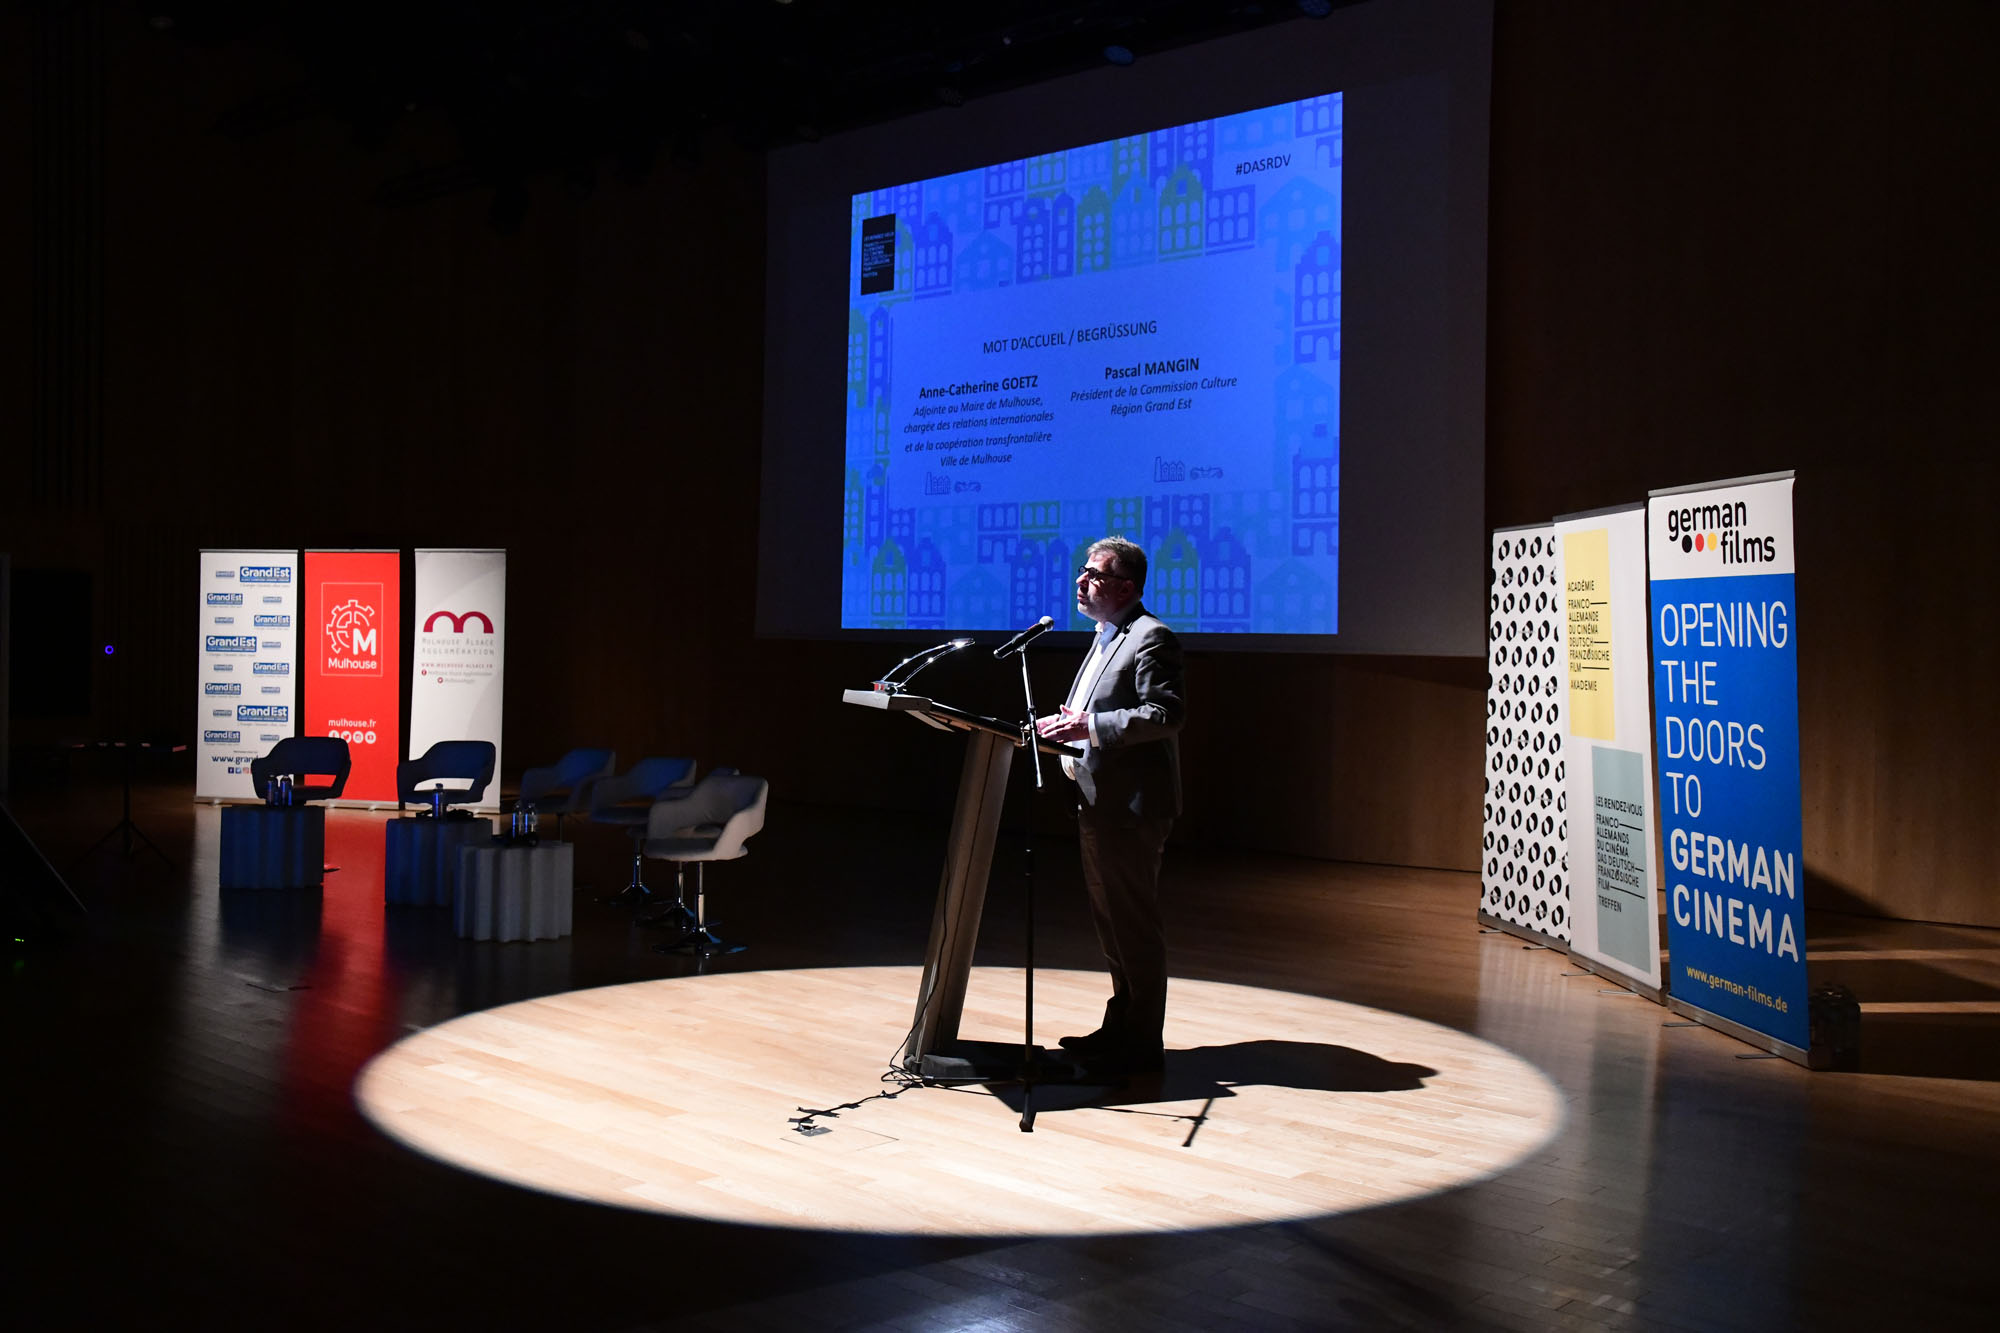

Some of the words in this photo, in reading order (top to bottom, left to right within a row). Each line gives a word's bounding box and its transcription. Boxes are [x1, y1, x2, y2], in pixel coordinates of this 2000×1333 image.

[1236, 154, 1291, 176] #DASRDV
[983, 340, 1008, 354] MOT
[1068, 329, 1075, 346] /
[1077, 320, 1158, 342] BEGRÜSSUNG
[1105, 363, 1141, 380] Pascal
[1144, 358, 1200, 376] MANGIN
[919, 380, 999, 399] Anne-Catherine
[1002, 375, 1038, 391] GOETZ
[1070, 388, 1112, 402] Président
[1115, 386, 1126, 398] de
[1129, 385, 1138, 396] la
[1140, 380, 1198, 396] Commission
[1200, 376, 1238, 390] Culture
[914, 404, 946, 418] Adjointe
[948, 404, 959, 414] au
[960, 401, 984, 412] Maire
[986, 398, 997, 410] de
[1000, 396, 1044, 408] Mulhouse,
[1111, 403, 1142, 417] Région
[1145, 399, 1175, 413] Grand
[1178, 398, 1192, 410] Est
[904, 421, 934, 436] chargée
[936, 420, 950, 431] des
[952, 417, 988, 429] relations
[990, 412, 1054, 426] internationales
[904, 442, 913, 452] et
[915, 442, 924, 452] de
[926, 442, 933, 451] la
[936, 437, 984, 452] coopération
[986, 432, 1052, 448] transfrontalière
[940, 456, 957, 467] Ville
[959, 455, 969, 466] de
[972, 453, 1012, 464] Mulhouse
[1668, 501, 1747, 542] german
[1720, 529, 1776, 565] films
[241, 567, 272, 577] Grand
[274, 567, 290, 577] Est
[1568, 579, 1595, 592] ACADÉMIE
[1569, 611, 1599, 622] ALLEMANDE
[1660, 600, 1788, 649] OPENING
[1569, 624, 1576, 634] DU
[1576, 623, 1598, 635] CINÉMA
[207, 636, 238, 647] Grand
[239, 636, 256, 647] Est
[352, 628, 377, 656] M
[328, 657, 377, 670] Mulhouse
[1570, 680, 1598, 692] AKADEMIE
[1660, 660, 1718, 706] THE
[238, 706, 270, 716] Grand
[271, 706, 287, 716] Est
[328, 718, 377, 728] mulhouse.fr
[1666, 716, 1766, 770] DOORS
[1666, 772, 1702, 818] TO
[1596, 796, 1604, 807] LES
[1604, 798, 1643, 816] RENDEZ-VOUS
[1596, 827, 1629, 844] ALLEMANDS
[1597, 839, 1604, 850] DU
[1605, 842, 1629, 856] CINÉMA
[1597, 852, 1607, 865] DAS
[1670, 828, 1795, 900] GERMAN
[1598, 894, 1622, 913] TREFFEN
[1673, 884, 1799, 964] CINEMA
[1686, 966, 1788, 1013] www.german-films.de
